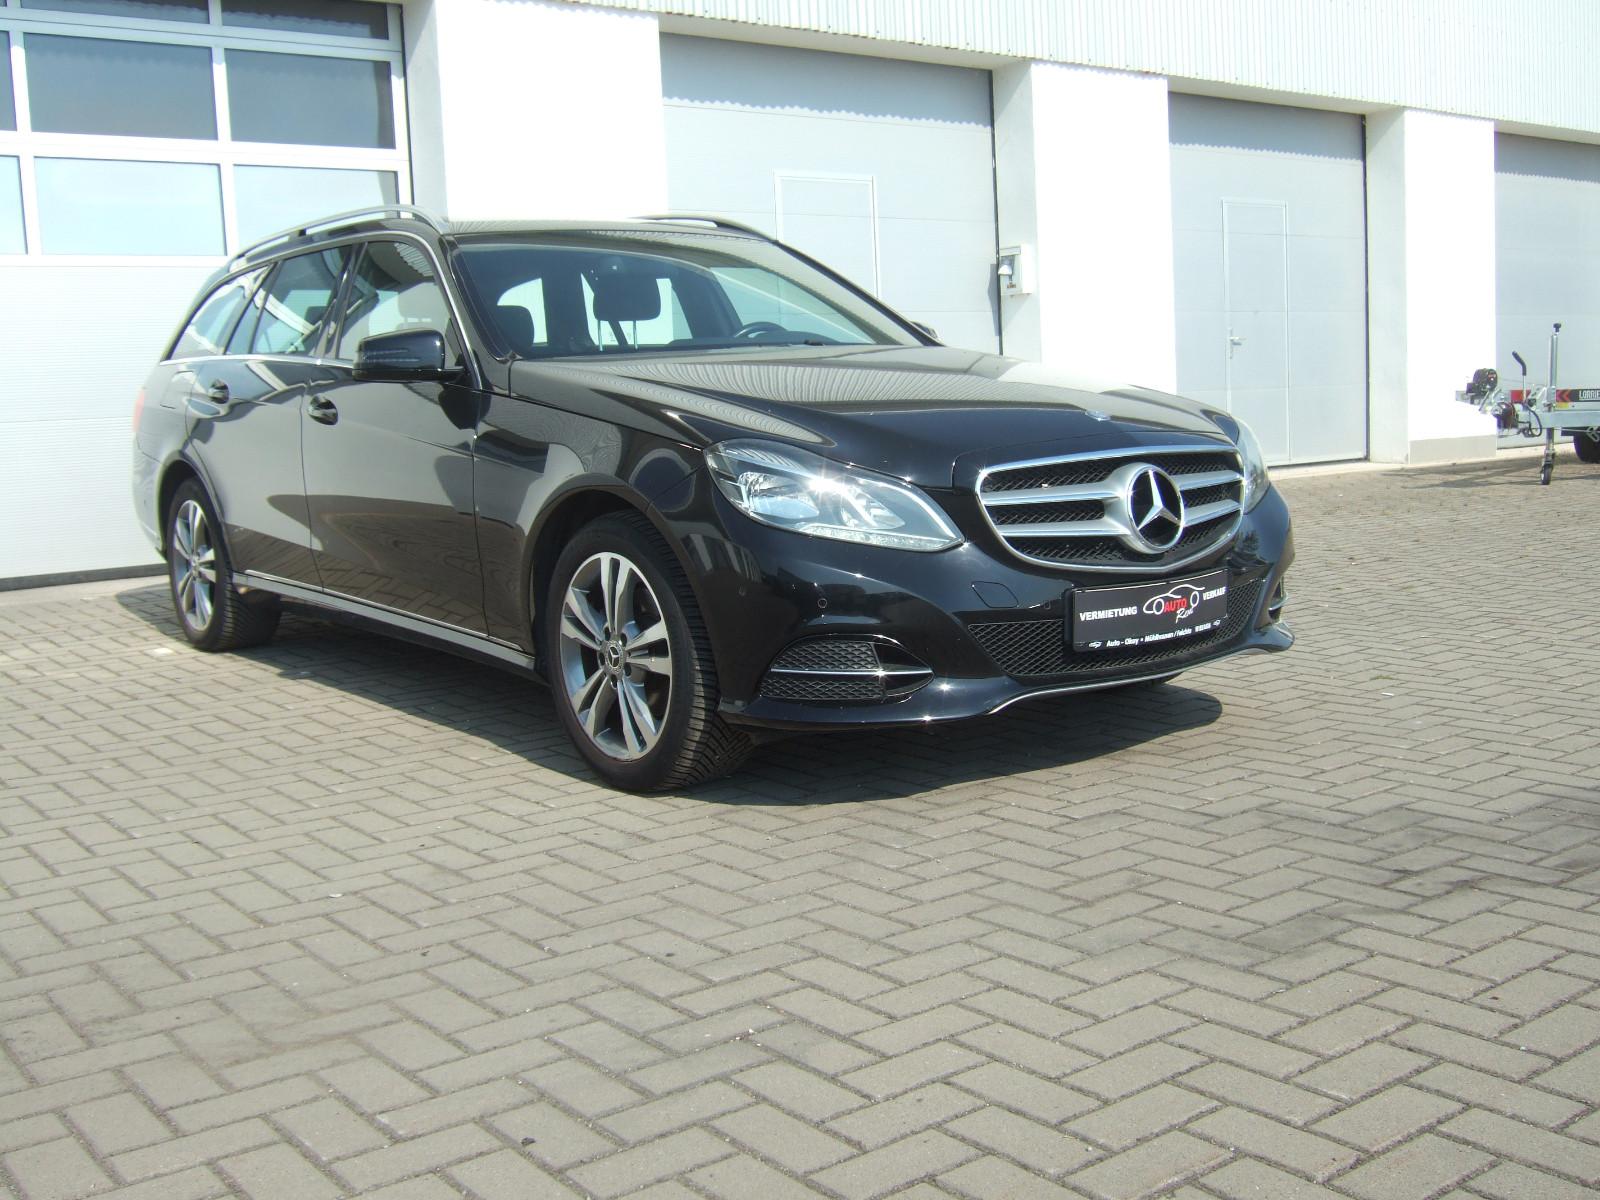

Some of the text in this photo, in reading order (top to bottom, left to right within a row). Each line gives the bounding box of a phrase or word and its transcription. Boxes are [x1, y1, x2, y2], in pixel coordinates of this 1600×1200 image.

[1202, 586, 1226, 600] VERKAUF
[1164, 598, 1187, 612] AUTO
[1080, 606, 1137, 621] VERMIETUNG
[1106, 639, 1120, 647] Auto
